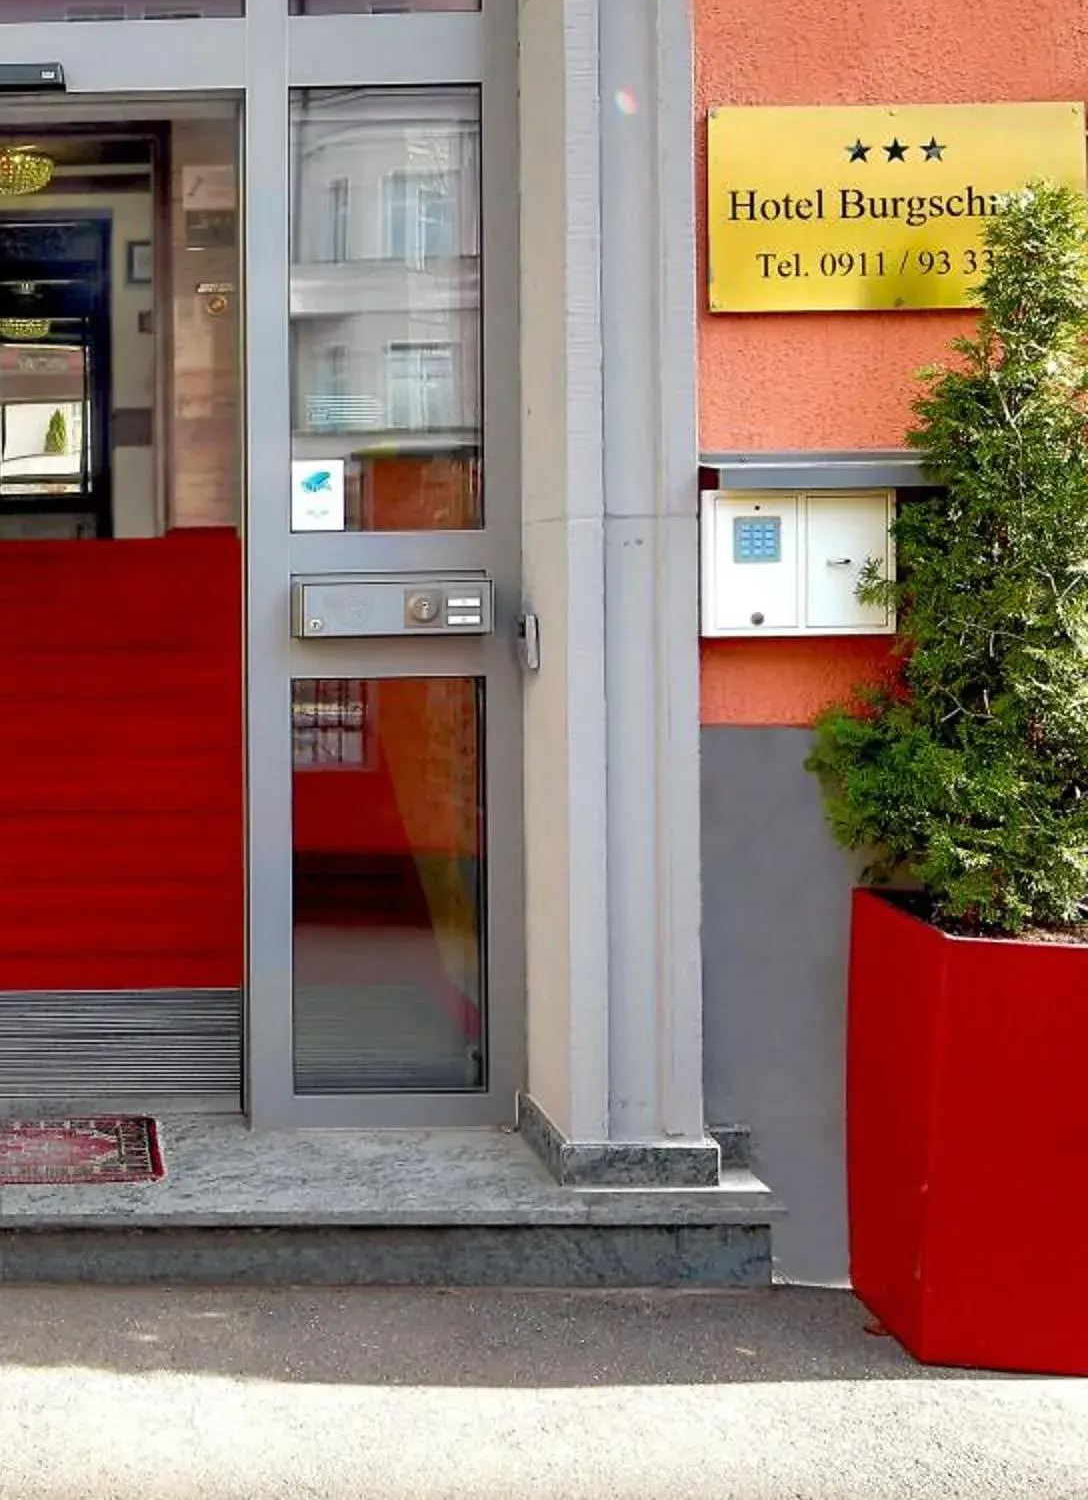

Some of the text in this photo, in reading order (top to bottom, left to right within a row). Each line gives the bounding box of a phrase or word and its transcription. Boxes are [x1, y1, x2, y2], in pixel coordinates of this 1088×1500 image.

[729, 189, 823, 221] Hotel
[756, 252, 809, 278] Tel.
[820, 250, 885, 277] 0911
[918, 248, 951, 275] 93
